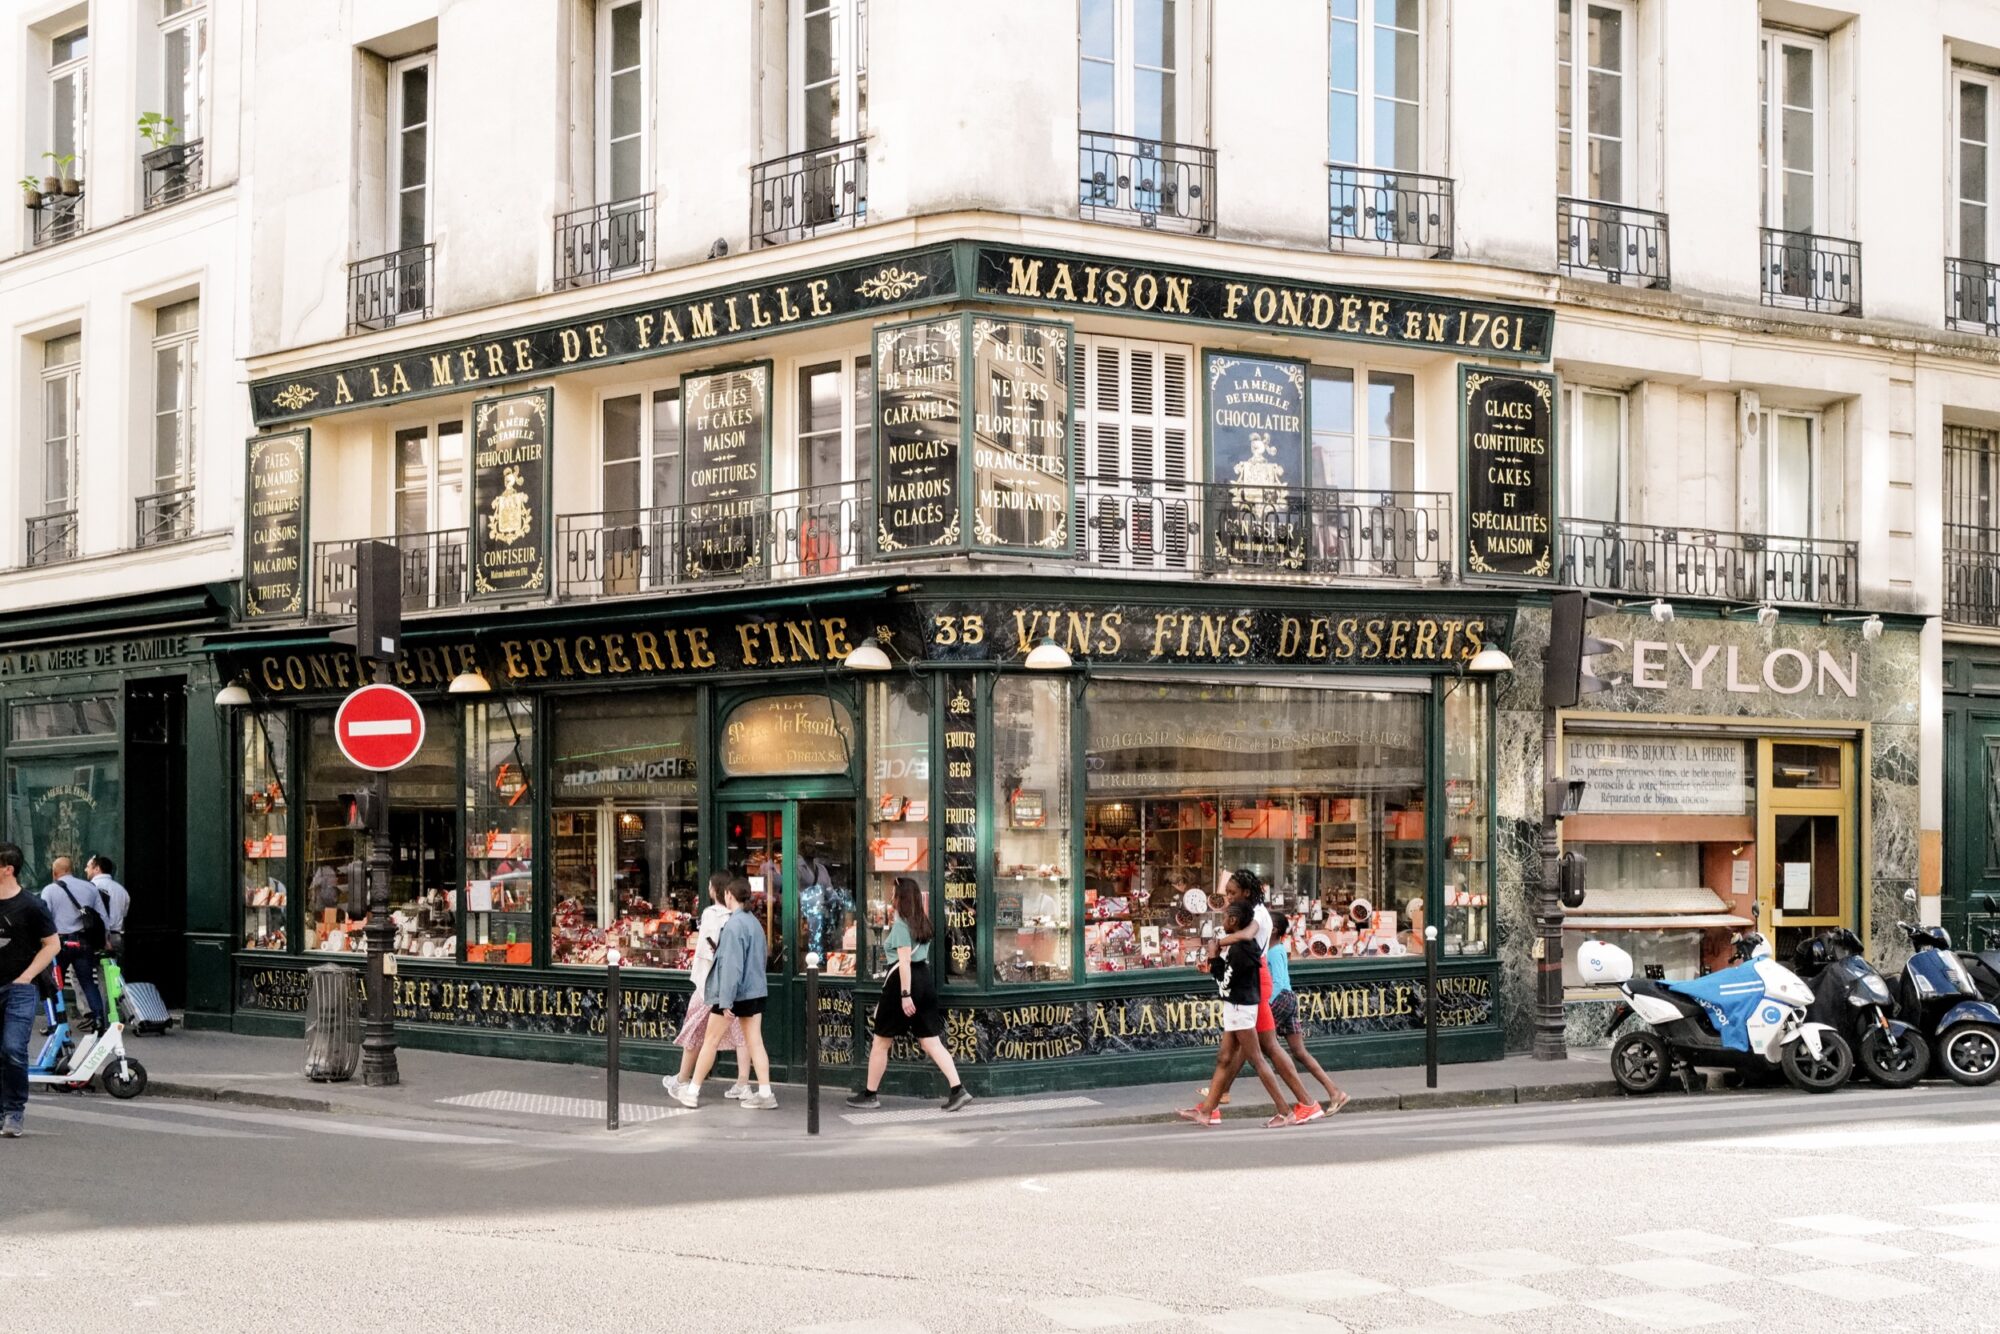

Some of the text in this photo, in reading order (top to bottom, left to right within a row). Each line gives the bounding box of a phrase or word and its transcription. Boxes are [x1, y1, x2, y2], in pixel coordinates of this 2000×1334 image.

[1006, 256, 1193, 314] MAISON
[1403, 310, 1447, 343] EN
[1456, 310, 1524, 352] 1761
[335, 375, 353, 405] A
[370, 363, 411, 397] LA
[559, 324, 607, 363] DE
[635, 279, 832, 349] FAMILLE
[899, 342, 939, 366] PÂTES
[886, 363, 953, 391] DE FRUITS
[1015, 367, 1025, 377] DE
[1254, 366, 1262, 378] A
[992, 378, 1049, 401] NEVERS
[1234, 379, 1249, 391] LA
[704, 388, 747, 411] GLACES
[1226, 393, 1290, 411] DE FAMILLE
[1485, 399, 1532, 419] GLACES
[508, 405, 515, 416] A
[697, 408, 753, 431] ET CAKES
[884, 398, 955, 426] CARAMELS
[1216, 409, 1300, 433] CHOCOLATIER
[493, 421, 505, 432] LA
[975, 414, 1065, 439] FLORENTINS
[487, 430, 535, 447] DE FAMILLE
[704, 430, 746, 453] MAISON
[1474, 432, 1544, 455] CONFITURES
[264, 452, 290, 470] PÂTES
[479, 444, 542, 468] CHOCOLATIER
[889, 439, 949, 464] NOUGATS
[975, 449, 1065, 474] ORANGETTES
[254, 468, 300, 490] D'AMANDES
[691, 463, 757, 488] CONFITURES
[1488, 466, 1531, 487] CAKES
[887, 478, 951, 503] MARRONS
[981, 489, 1061, 512] MENDIANTS
[1503, 492, 1515, 508] ET
[253, 496, 300, 517] GUIMAUVES
[1472, 510, 1547, 533] SPÉCIALITÉS
[254, 525, 297, 545] CALISSONS
[1487, 536, 1532, 555] MAISON
[253, 556, 297, 575] MACARONS
[484, 547, 536, 567] CONFISEUR
[258, 583, 291, 600] TRUFFES
[935, 614, 984, 645] 35
[1013, 610, 1485, 660] VINS FINS DESSERTS
[1, 656, 12, 675] A
[20, 654, 40, 674] LA
[94, 645, 112, 665] DE
[123, 637, 184, 662] FAMILLE
[501, 627, 716, 679] EPICERIE
[735, 617, 853, 665] FINE
[945, 731, 975, 749] FRUITS
[1570, 743, 1582, 758] LE
[1621, 745, 1639, 760] DES
[1642, 745, 1677, 763] BIJOUX
[1686, 747, 1698, 761] LA
[1702, 747, 1736, 762] PIERRE
[949, 762, 971, 778] SECS
[1571, 765, 1584, 776] Des
[1588, 767, 1613, 780] pierres
[1681, 768, 1690, 777] de
[1626, 780, 1635, 790] de
[1600, 792, 1641, 806] Réparation
[1643, 793, 1653, 803] de
[945, 808, 975, 824] FRUITS
[946, 837, 975, 853] CONFITS
[944, 882, 976, 899] CHOCOLATS
[442, 981, 468, 1009] DE
[481, 984, 582, 1017] FAMILLE
[833, 999, 853, 1015] SECS
[627, 1011, 637, 1019] DE
[1003, 1006, 1073, 1029] FABRIQUE
[1118, 1005, 1158, 1036] LA
[1165, 996, 1225, 1032] MÈR
[1297, 985, 1412, 1022] FAMILLE
[590, 1015, 677, 1038] COFITURES
[1034, 1027, 1044, 1037] DE
[996, 1034, 1082, 1060] CONFITURES
